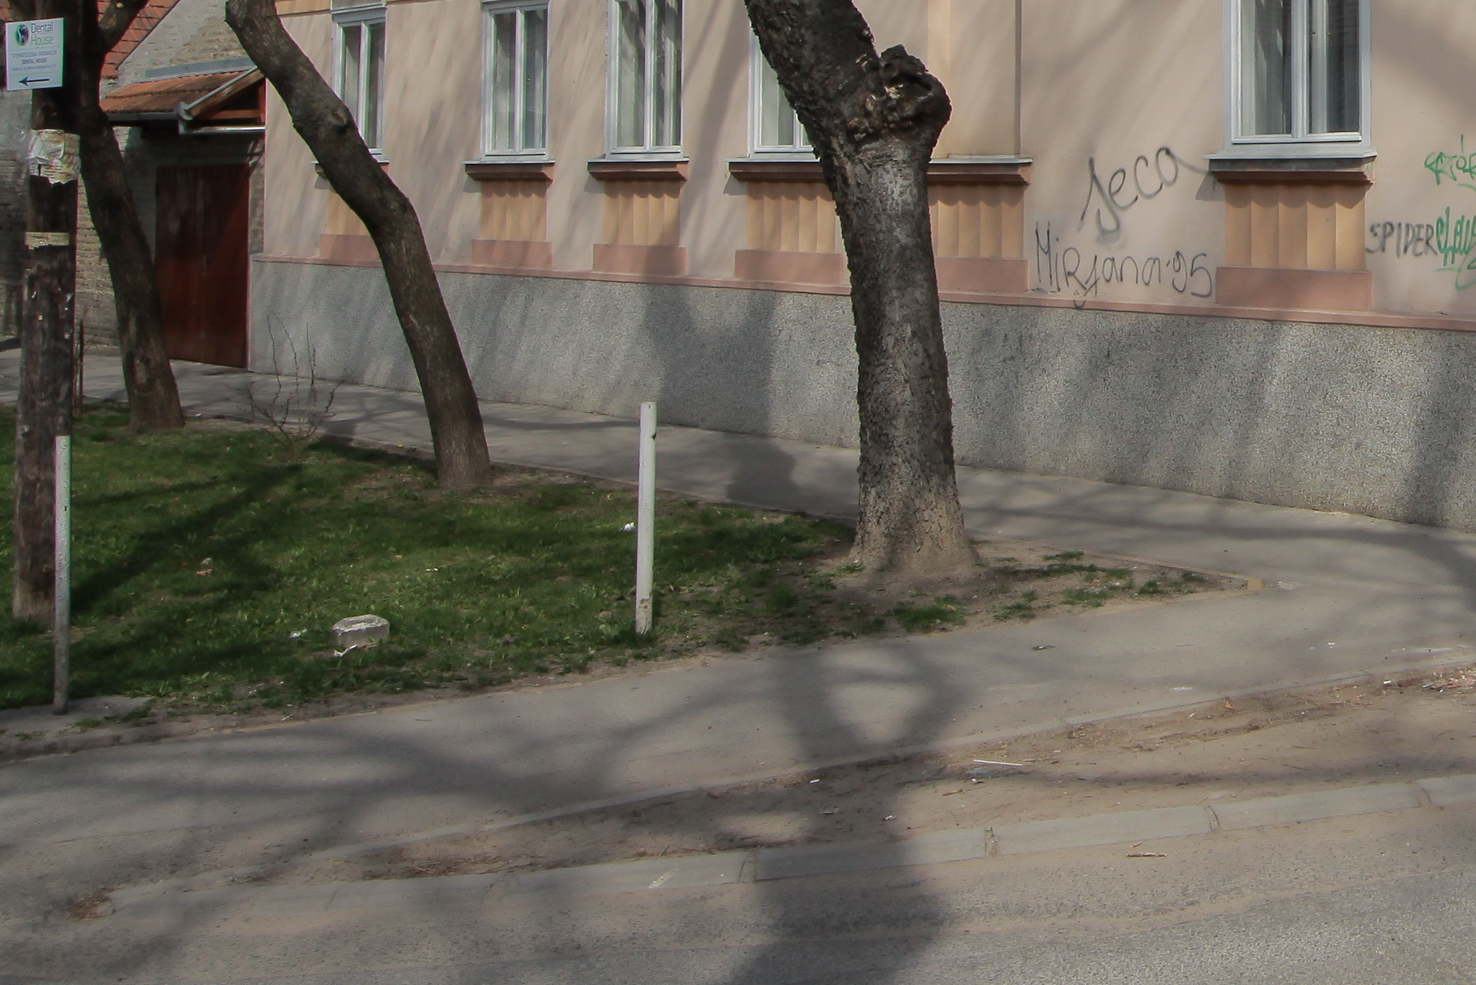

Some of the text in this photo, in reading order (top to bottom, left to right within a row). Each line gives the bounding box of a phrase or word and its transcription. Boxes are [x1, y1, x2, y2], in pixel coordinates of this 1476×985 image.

[31, 22, 54, 33] Dental
[31, 36, 54, 46] House
[1365, 221, 1438, 258] SPIDER
